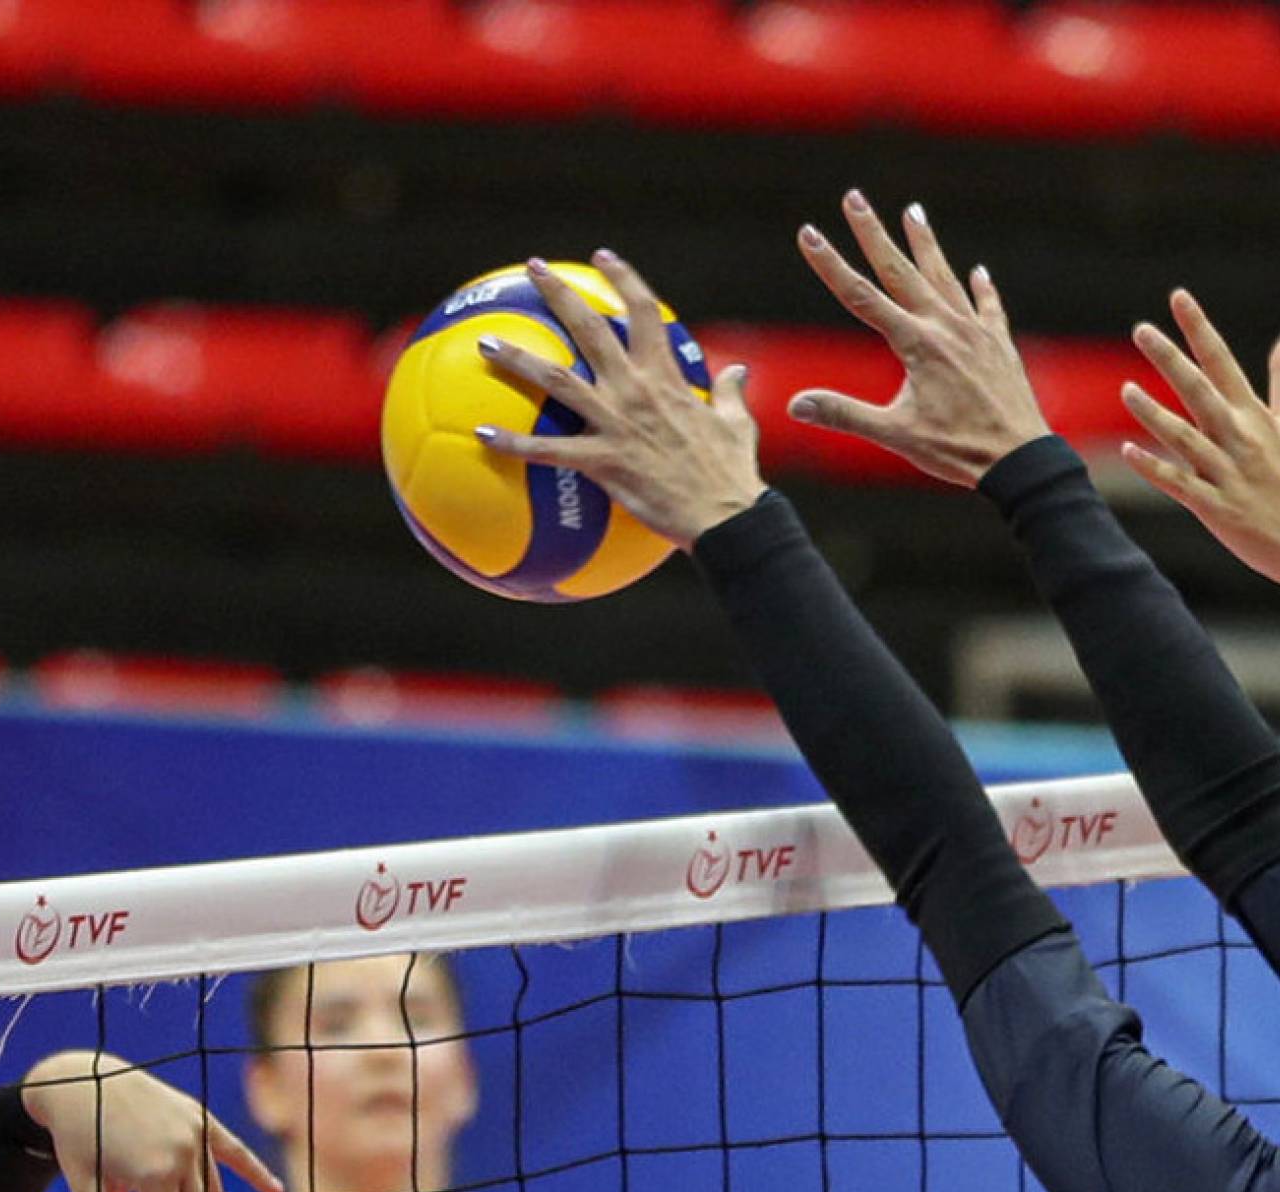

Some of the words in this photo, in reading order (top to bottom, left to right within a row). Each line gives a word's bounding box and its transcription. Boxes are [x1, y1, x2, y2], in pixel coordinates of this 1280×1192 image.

[1061, 811, 1117, 847] TVF
[737, 845, 796, 882] TVF
[407, 878, 468, 917] TVF
[69, 910, 130, 951] TVF
